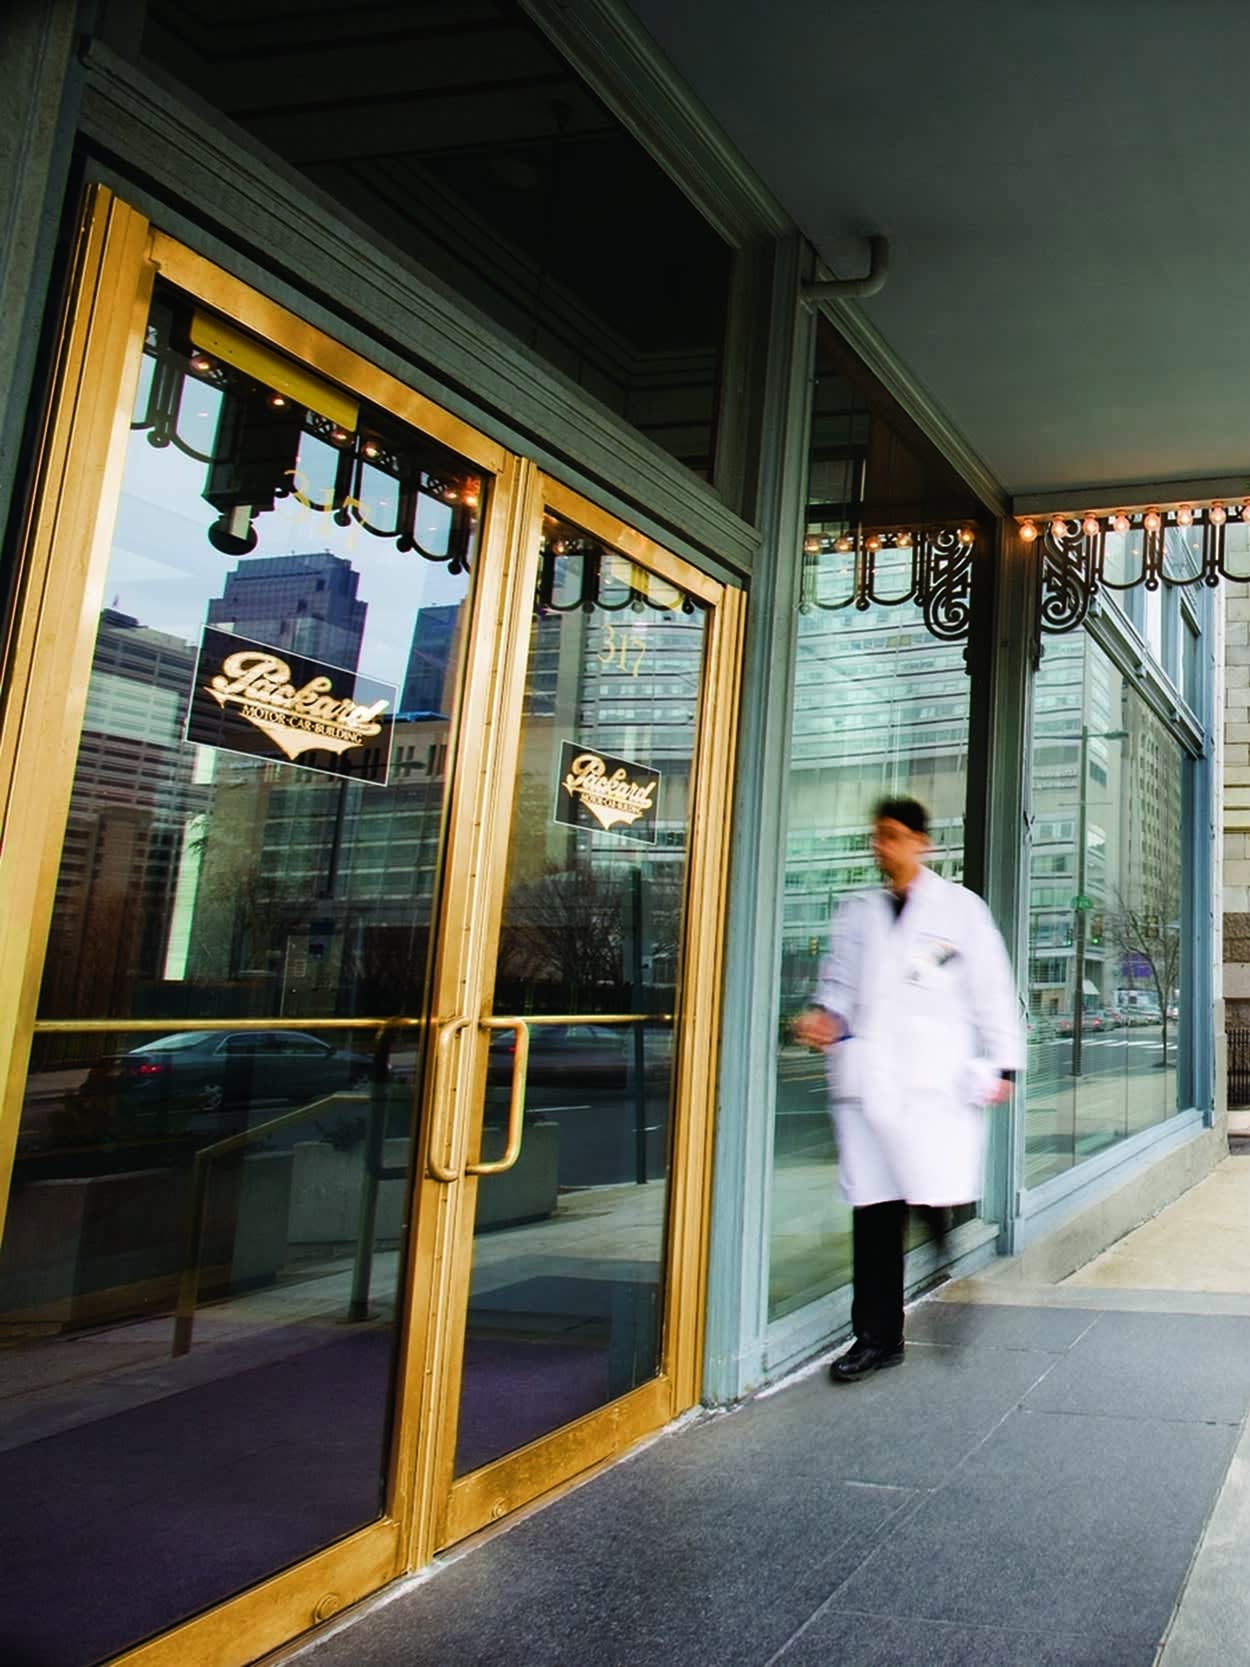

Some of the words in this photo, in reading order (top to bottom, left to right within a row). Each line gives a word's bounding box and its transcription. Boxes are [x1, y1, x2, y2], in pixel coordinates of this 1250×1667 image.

[597, 624, 647, 678] 317
[211, 651, 390, 732] Packard
[566, 754, 657, 805] Packard
